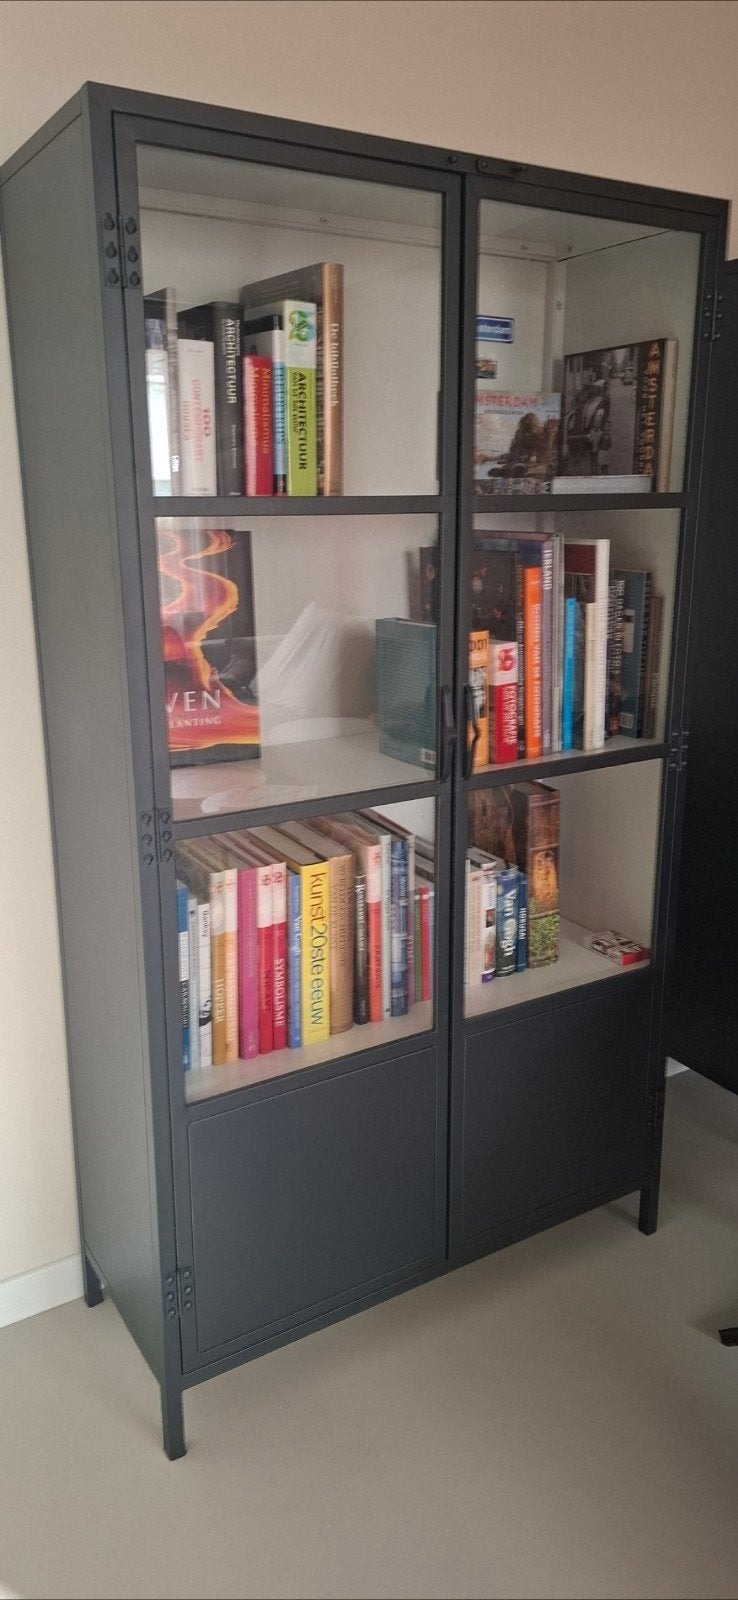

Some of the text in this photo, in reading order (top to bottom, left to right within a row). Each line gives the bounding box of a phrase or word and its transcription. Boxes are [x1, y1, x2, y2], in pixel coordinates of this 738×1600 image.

[226, 319, 238, 405] ARCHITECTUUR
[329, 322, 339, 408] De bibliotheek
[191, 379, 204, 464] CONTEMPORARY
[203, 406, 212, 438] 100
[261, 367, 272, 455] Minimalismus
[299, 371, 308, 470] ARCHITECTUUR
[473, 395, 538, 408] MSTERDAM
[640, 341, 662, 477] AMSTERDA
[541, 548, 554, 591] IERLAND
[165, 689, 221, 713] VEN
[508, 684, 518, 744] FOTOGRAFIE
[309, 871, 328, 921] kunst
[201, 910, 210, 938] Banksy
[290, 933, 302, 956] Gogh
[293, 915, 302, 932] Van
[499, 888, 518, 957] Van Gogh
[517, 907, 527, 941] HOKUSAI
[309, 924, 328, 976] 20ste
[214, 978, 226, 1024] HOPPER
[275, 958, 287, 1028] SYMBOLISME
[309, 977, 325, 1026] eeuw
